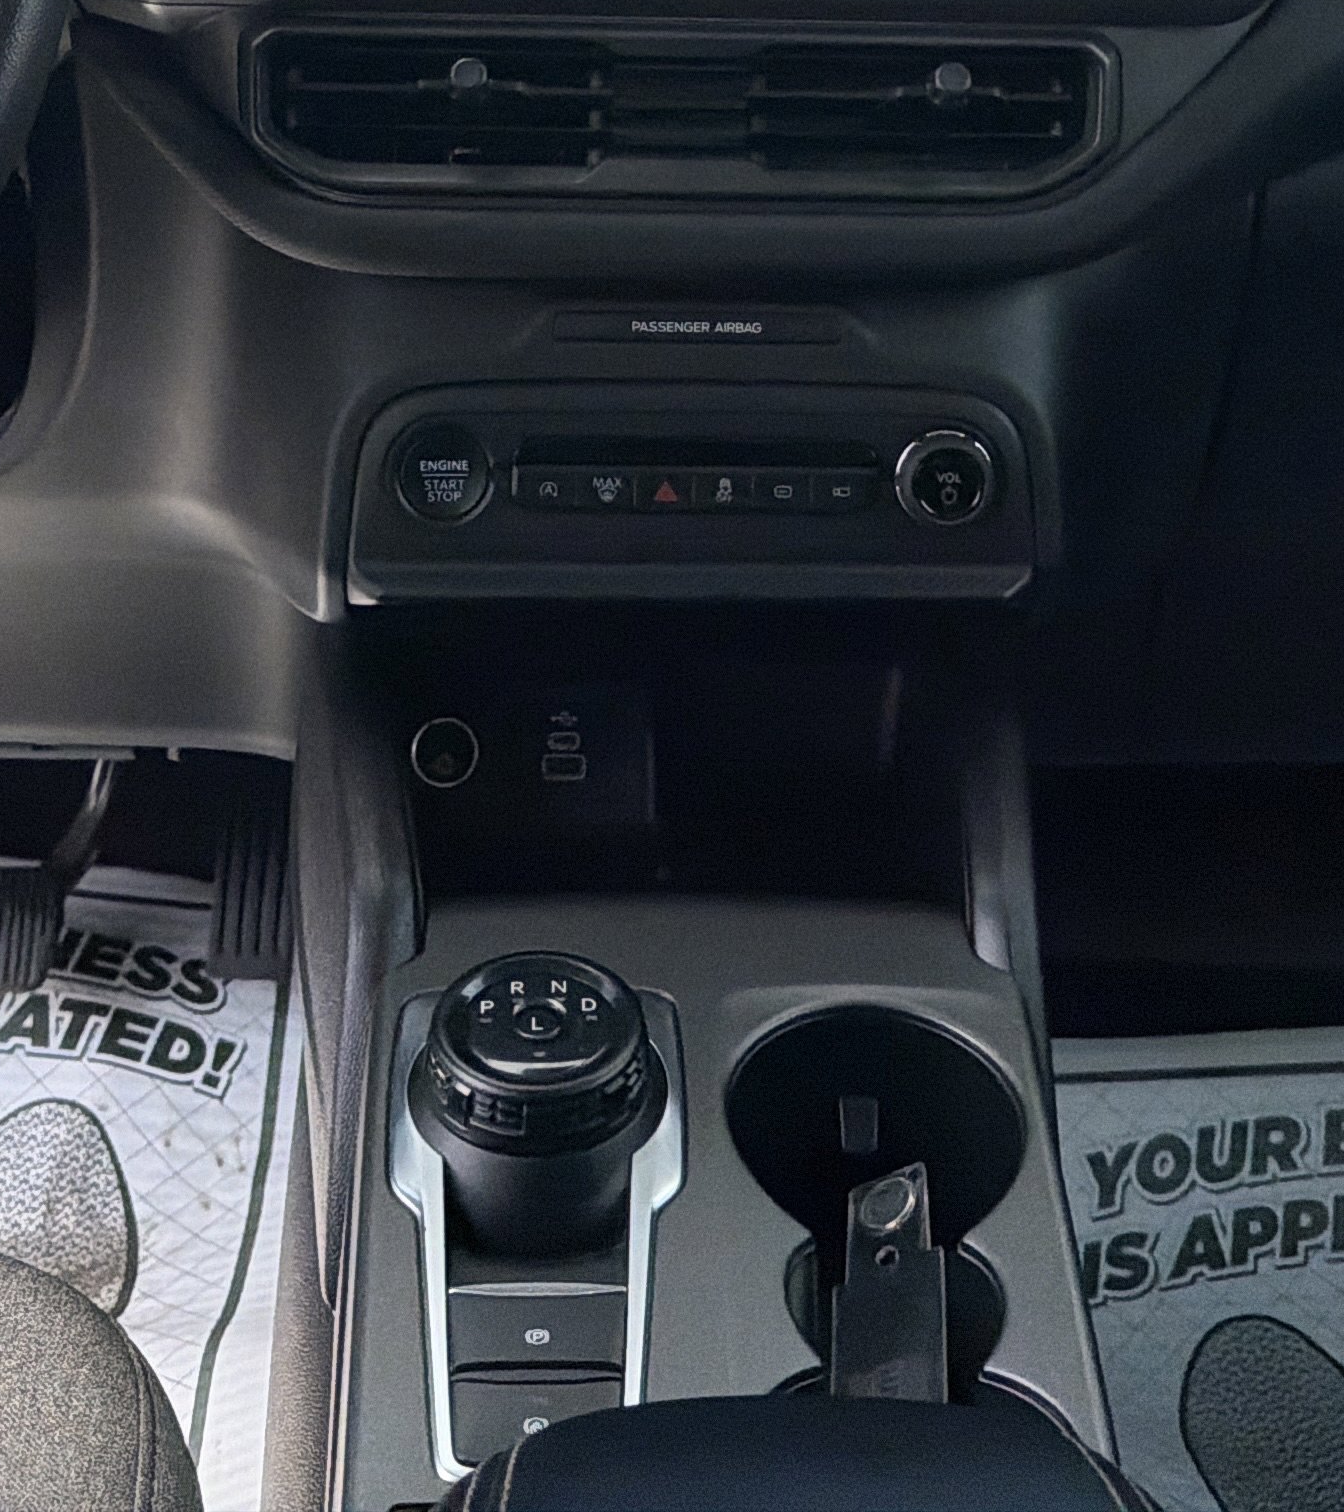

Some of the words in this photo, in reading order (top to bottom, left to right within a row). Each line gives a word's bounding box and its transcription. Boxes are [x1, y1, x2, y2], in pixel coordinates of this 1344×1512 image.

[631, 321, 710, 333] PASSENGER
[714, 321, 763, 334] AIRBAG
[419, 459, 470, 473] ENGINE
[592, 476, 623, 489] MAX
[936, 471, 961, 484] VOL
[423, 479, 465, 491] START
[427, 491, 463, 503] STOP
[510, 981, 525, 995] R
[551, 980, 567, 994] N
[480, 1000, 495, 1014] P
[581, 998, 597, 1012] D
[531, 1017, 544, 1031] L
[1086, 1114, 1307, 1214] YOUR
[1083, 1230, 1158, 1300] IS
